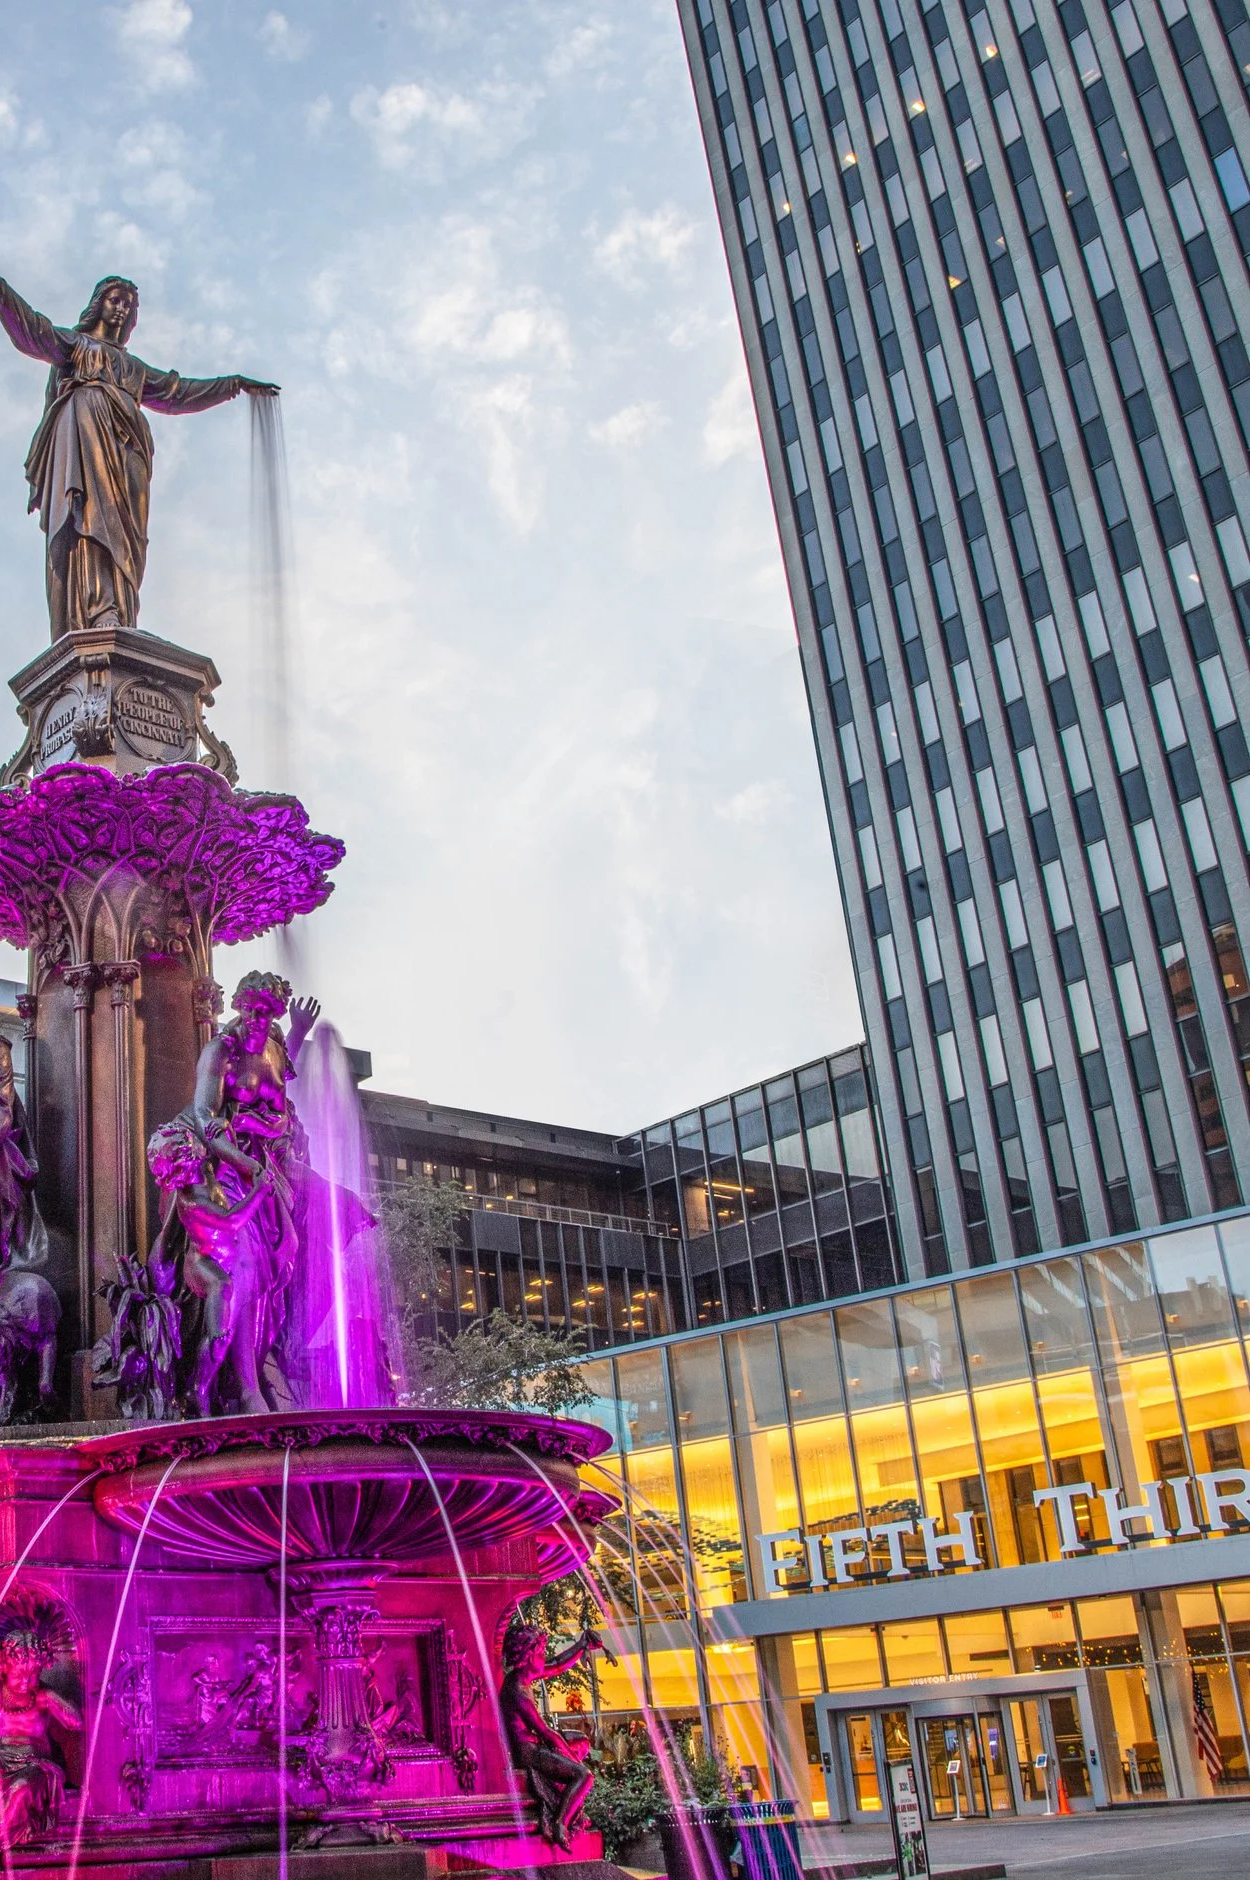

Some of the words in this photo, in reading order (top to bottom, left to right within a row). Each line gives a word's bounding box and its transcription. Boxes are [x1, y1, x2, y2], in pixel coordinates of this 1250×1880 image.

[130, 688, 148, 705] TO
[149, 693, 174, 713] THE
[46, 706, 77, 739] HENRY
[122, 701, 168, 728] PEOPLE
[169, 714, 185, 732] OF
[123, 717, 184, 748] CINCINNATI
[754, 1511, 982, 1592] FIFTH
[1033, 1468, 1250, 1552] THIR
[910, 1675, 947, 1686] VISITOR
[948, 1672, 979, 1682] ENTRY
